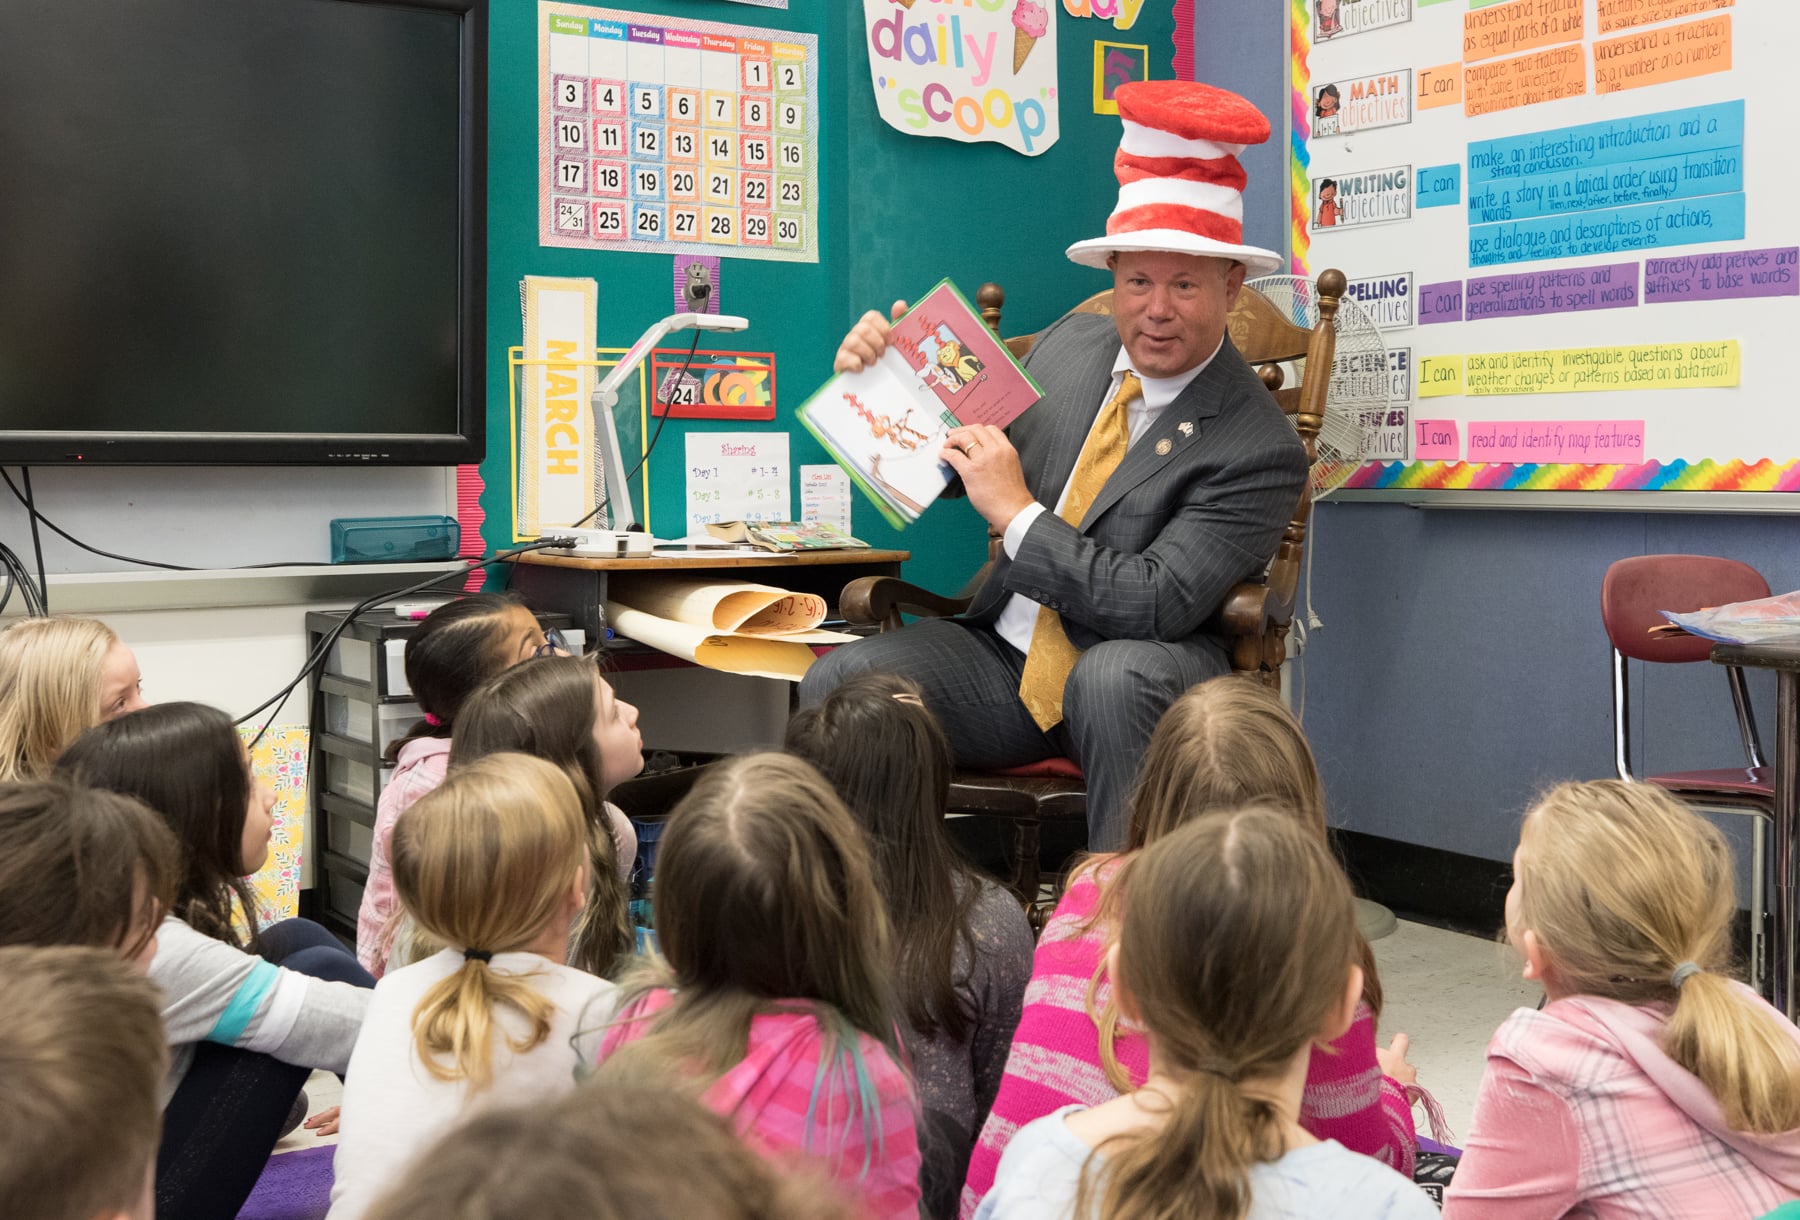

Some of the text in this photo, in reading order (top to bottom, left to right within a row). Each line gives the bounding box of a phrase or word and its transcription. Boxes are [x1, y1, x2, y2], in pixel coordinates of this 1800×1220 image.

[1344, 0, 1406, 31] objectives
[556, 19, 583, 33] Sunday
[593, 22, 623, 38] Monday
[631, 27, 660, 42] Tuesday
[665, 31, 700, 46] Wednesday
[703, 36, 736, 51] Thursday
[743, 41, 765, 54] Friday
[1464, 36, 1476, 52] as
[1480, 24, 1509, 52] equal
[1513, 19, 1538, 48] parts
[1663, 20, 1724, 46] a fraction
[871, 9, 997, 86] daily
[1534, 48, 1578, 69] fractions
[754, 65, 794, 85] 1 2
[1596, 68, 1607, 83] as
[1609, 67, 1616, 81] a
[1620, 57, 1658, 78] number
[1686, 40, 1727, 63] number
[1350, 75, 1399, 101] MATH
[1419, 72, 1454, 97] I can
[566, 85, 795, 124] 3 4 5 6 7 8 9
[1342, 97, 1405, 128] objectives
[562, 125, 799, 162] 10 11 12 13 14 15 16
[1472, 114, 1718, 168] make an interesting introduction and a
[1470, 151, 1737, 210] write a story in a logical order using transition
[1491, 156, 1582, 178] strong conclusion.
[563, 165, 799, 200] 17 18 19 20 21 22 23
[1339, 169, 1407, 197] WRITING
[1418, 170, 1454, 195] I can
[1344, 191, 1407, 223] objectives
[1482, 206, 1512, 222] words
[600, 212, 796, 238] 25 26 27 28 29 30
[1470, 204, 1713, 254] use dialogue and descriptions of actions,
[1529, 243, 1562, 259] feelings
[1568, 242, 1578, 255] to
[1580, 238, 1619, 253] develop
[1702, 253, 1722, 269] add
[1726, 251, 1769, 273] prefixes
[1776, 250, 1798, 265] and
[1348, 277, 1408, 301] PELLING
[1467, 267, 1611, 298] use spelling patterns and
[1645, 267, 1791, 295] suffixes to base words
[1420, 291, 1432, 315] I
[1435, 295, 1462, 312] can
[1466, 281, 1634, 320] generalizations to spell words
[1420, 360, 1456, 383] I can
[1467, 343, 1728, 373] ask and identify investigable questions about
[1468, 371, 1512, 387] weather
[1515, 372, 1555, 390] changes
[1559, 371, 1570, 383] or
[1574, 366, 1619, 389] patterns
[1624, 365, 1654, 383] based
[1657, 368, 1670, 380] on
[1675, 363, 1699, 380] data
[545, 340, 579, 475] MARCH
[673, 388, 693, 405] 24
[1419, 422, 1429, 446] I
[1432, 432, 1452, 446] can
[1472, 424, 1641, 456] read and identify map features
[721, 443, 757, 457] Sharing
[692, 467, 718, 480] Day 1
[692, 490, 711, 503] Day
